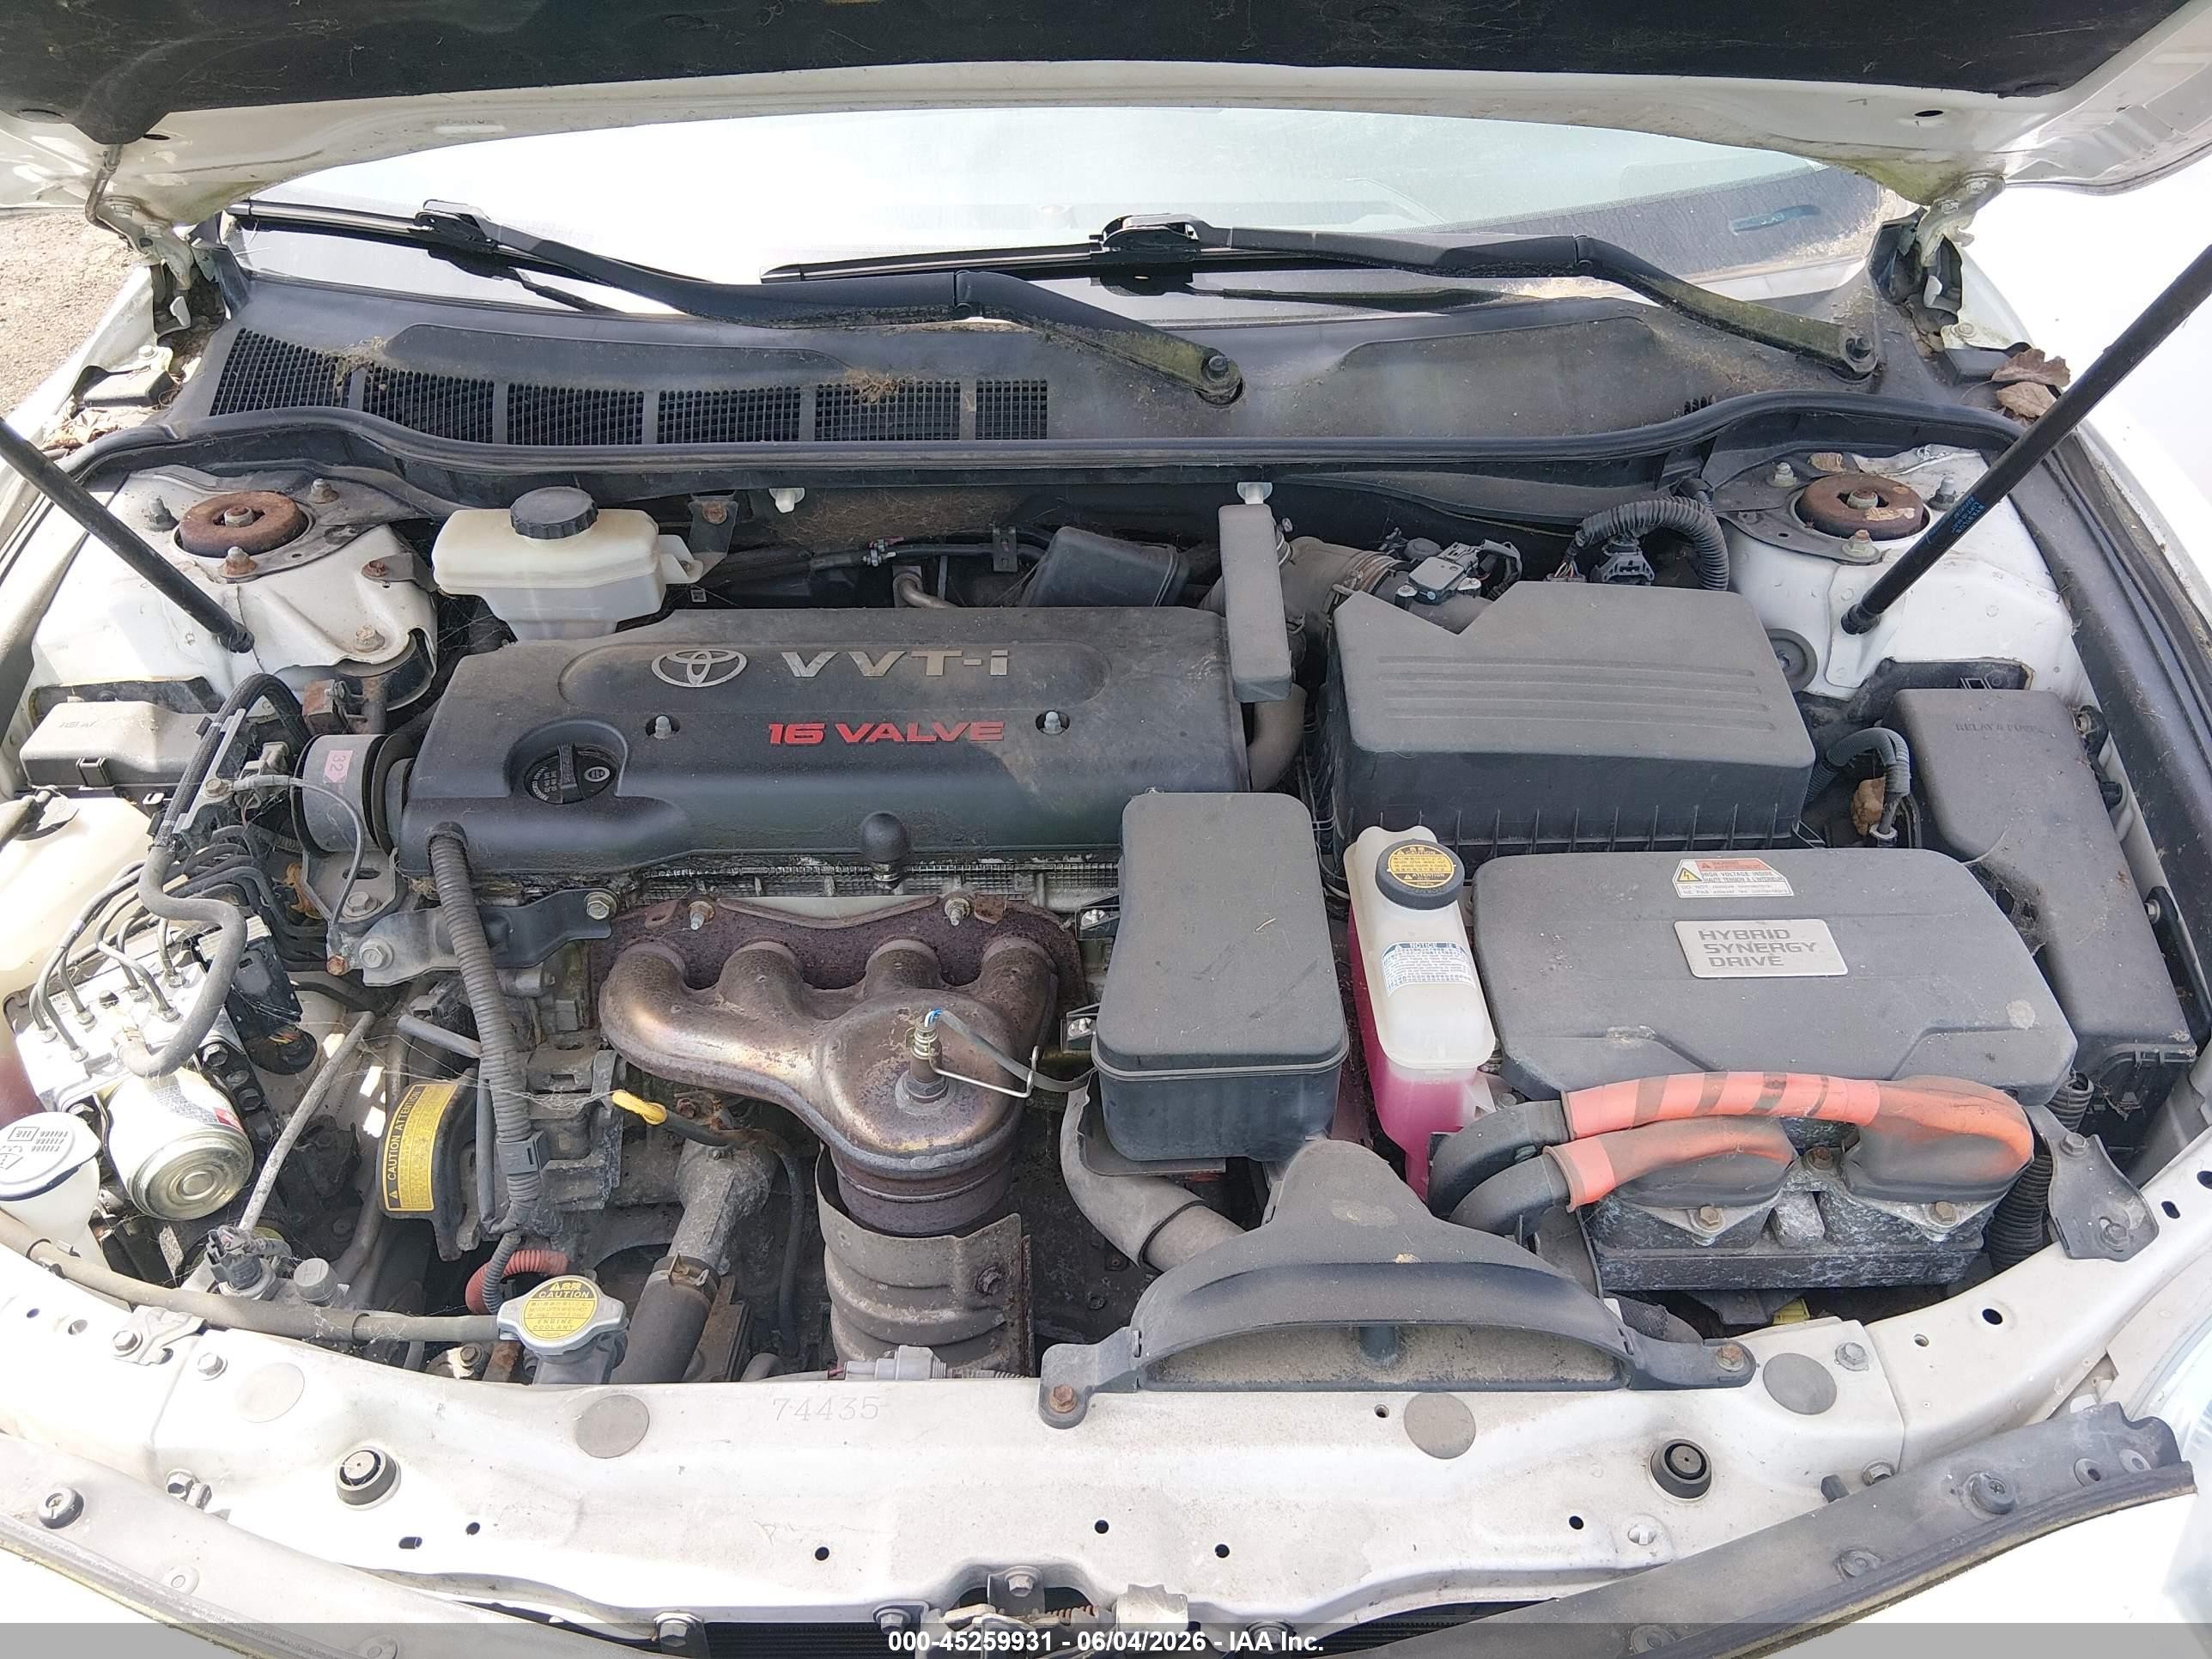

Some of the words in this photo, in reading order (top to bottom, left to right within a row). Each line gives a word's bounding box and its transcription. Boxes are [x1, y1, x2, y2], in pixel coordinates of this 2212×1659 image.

[781, 649, 1009, 678] VVT-i
[769, 722, 827, 745] 16
[834, 720, 1006, 744] VALVE
[1698, 929, 1790, 940] HYBRID
[1703, 942, 1817, 954] SYNERGY
[1708, 956, 1785, 967] DRIVE
[386, 1134, 401, 1182] CAUTION
[395, 1090, 422, 1131] ATTENTION
[773, 1395, 880, 1421] 74435
